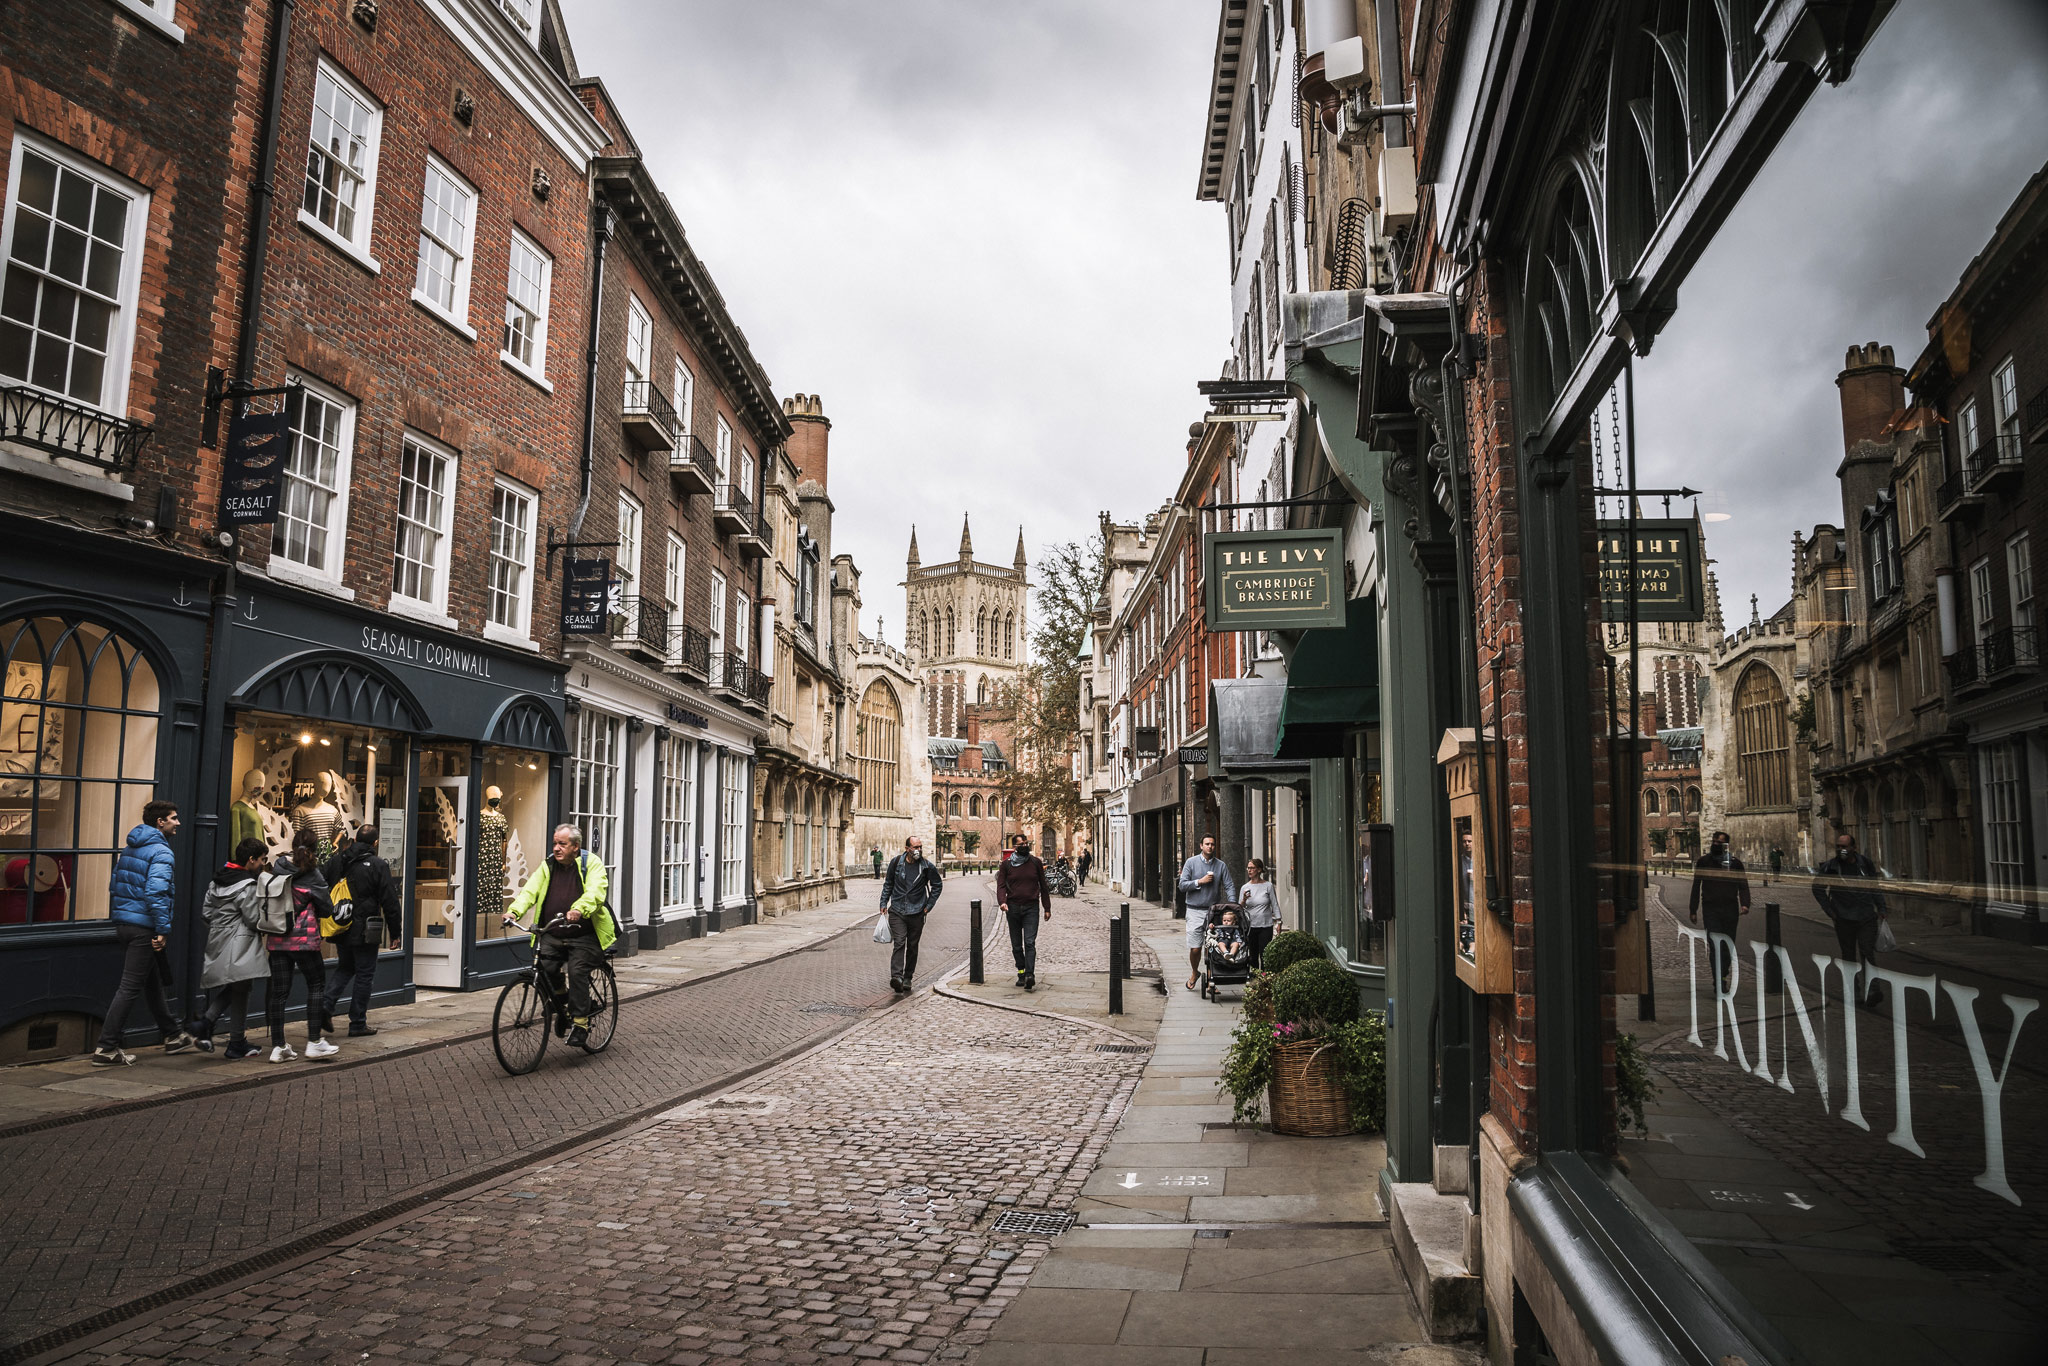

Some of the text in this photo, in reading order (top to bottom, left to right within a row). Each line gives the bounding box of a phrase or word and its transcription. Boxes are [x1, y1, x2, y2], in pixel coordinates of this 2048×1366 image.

[226, 495, 273, 510] SEASALT
[233, 510, 262, 518] CORNWALL
[1222, 548, 1327, 565] THE IVY
[1235, 577, 1316, 590] CAMBRIDGE
[1238, 589, 1313, 602] BRASSERIE
[564, 614, 600, 624] SEASALT
[361, 626, 491, 678] SEASALT CORNWALL
[1179, 749, 1208, 762] TOAS
[0, 813, 27, 831] OFF
[1677, 921, 2040, 1207] TRINITY
